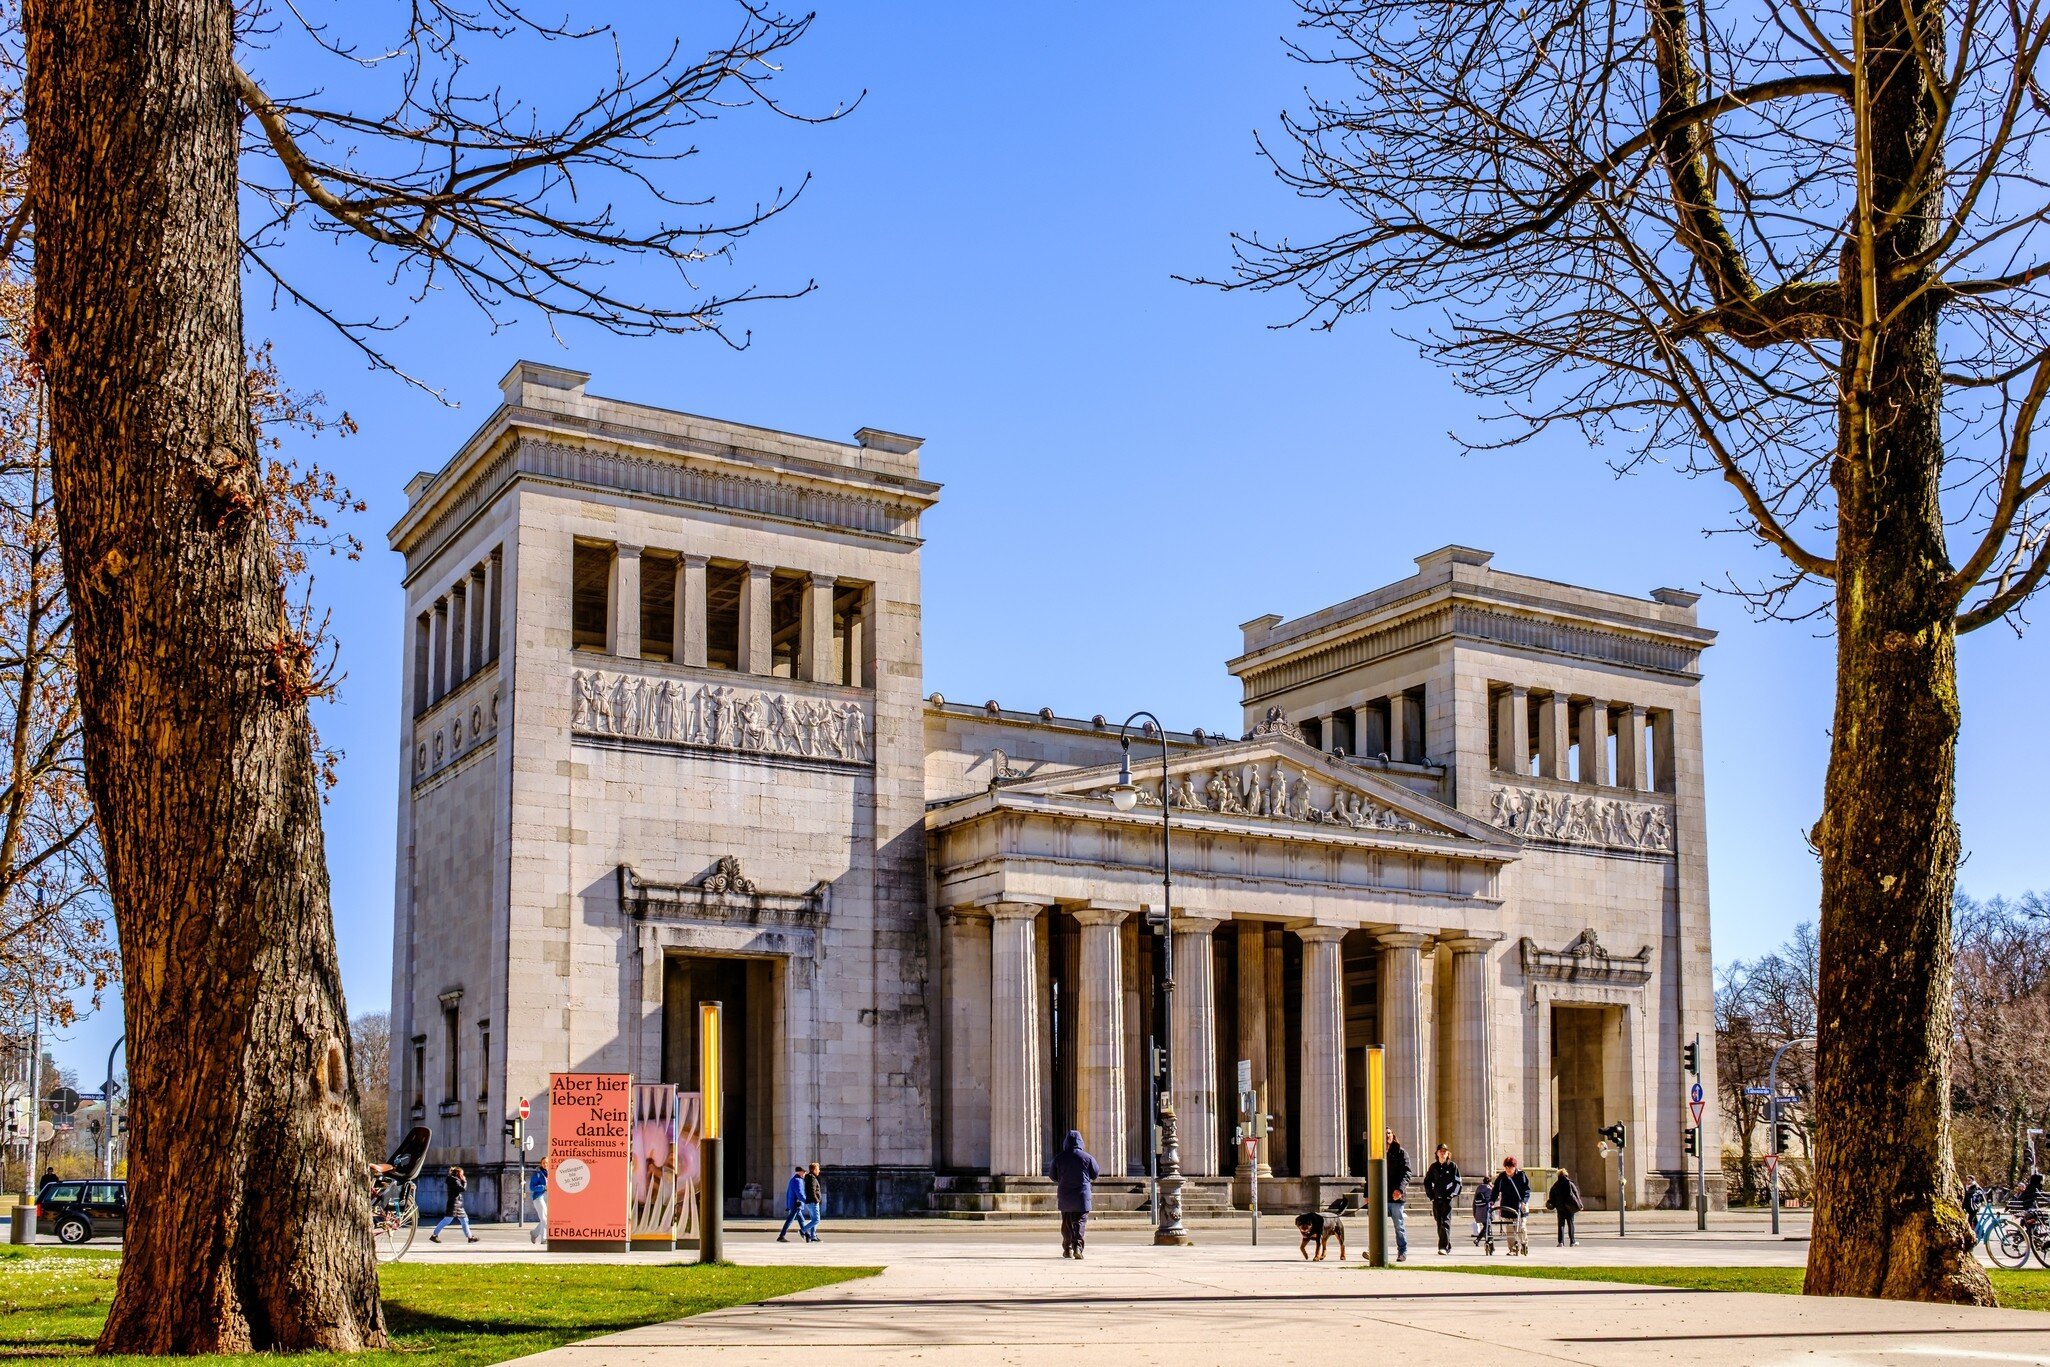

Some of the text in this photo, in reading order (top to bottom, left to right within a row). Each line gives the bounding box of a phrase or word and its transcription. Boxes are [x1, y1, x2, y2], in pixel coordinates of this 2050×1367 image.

[553, 1077, 628, 1091] Aber hier
[552, 1091, 603, 1106] leben?
[590, 1108, 628, 1121] Nein
[576, 1122, 628, 1137] danke.
[551, 1138, 617, 1147] Surrealismus
[551, 1148, 628, 1158] Antifaschismus
[548, 1228, 627, 1238] LENBACHHAUS
